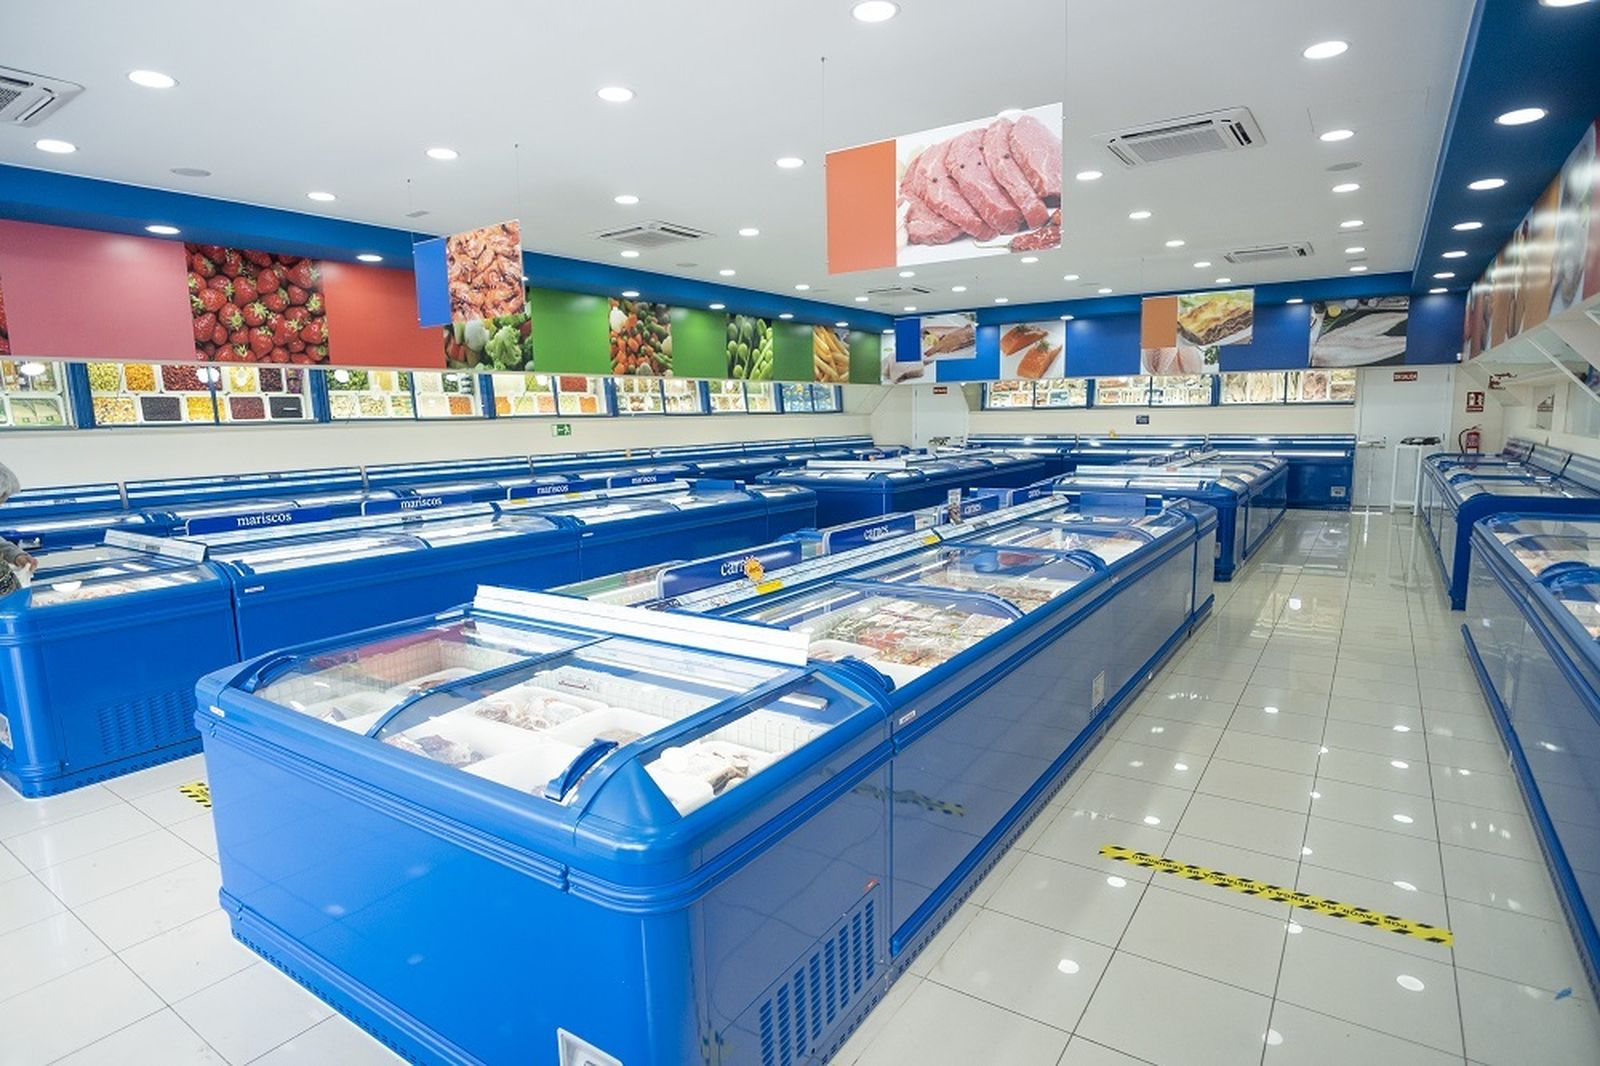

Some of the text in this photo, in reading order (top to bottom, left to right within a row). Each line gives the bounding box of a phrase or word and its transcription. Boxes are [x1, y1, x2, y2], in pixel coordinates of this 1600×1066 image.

[537, 484, 569, 495] mariscos
[400, 496, 443, 509] mariscos
[236, 511, 293, 526] mariscos
[1132, 854, 1184, 871] SEGURIDAD
[1203, 873, 1255, 890] DISTANCIA
[1276, 891, 1337, 911] MANTENGA
[1384, 919, 1408, 929] POR
